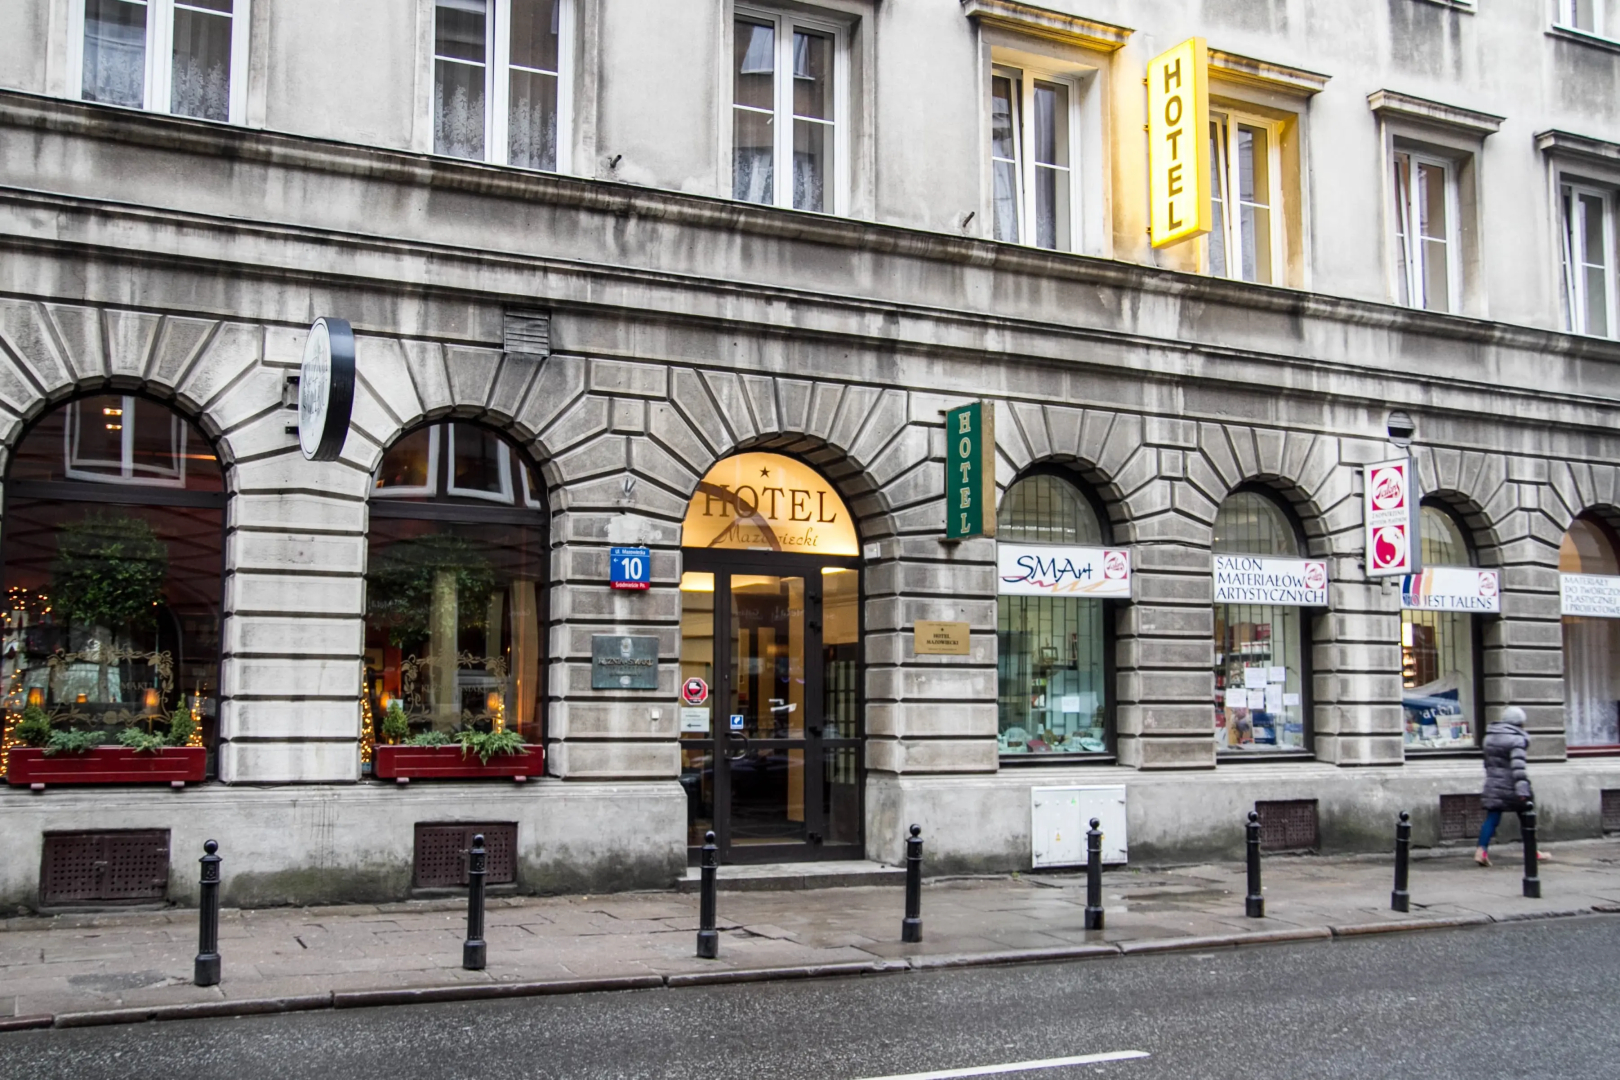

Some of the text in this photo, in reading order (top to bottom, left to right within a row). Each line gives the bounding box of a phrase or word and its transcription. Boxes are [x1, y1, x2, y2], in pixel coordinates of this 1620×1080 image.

[1163, 57, 1183, 232] HOTEL
[958, 411, 972, 534] HOTEL
[702, 484, 838, 524] HOTEL
[621, 557, 643, 580] 10
[1217, 556, 1263, 571] SALON
[1218, 571, 1306, 588] MATERIAŁÓW
[1216, 587, 1325, 603] ARTYSTYCZNYCH
[1564, 585, 1578, 594] DO
[1449, 595, 1492, 610] TALENS
